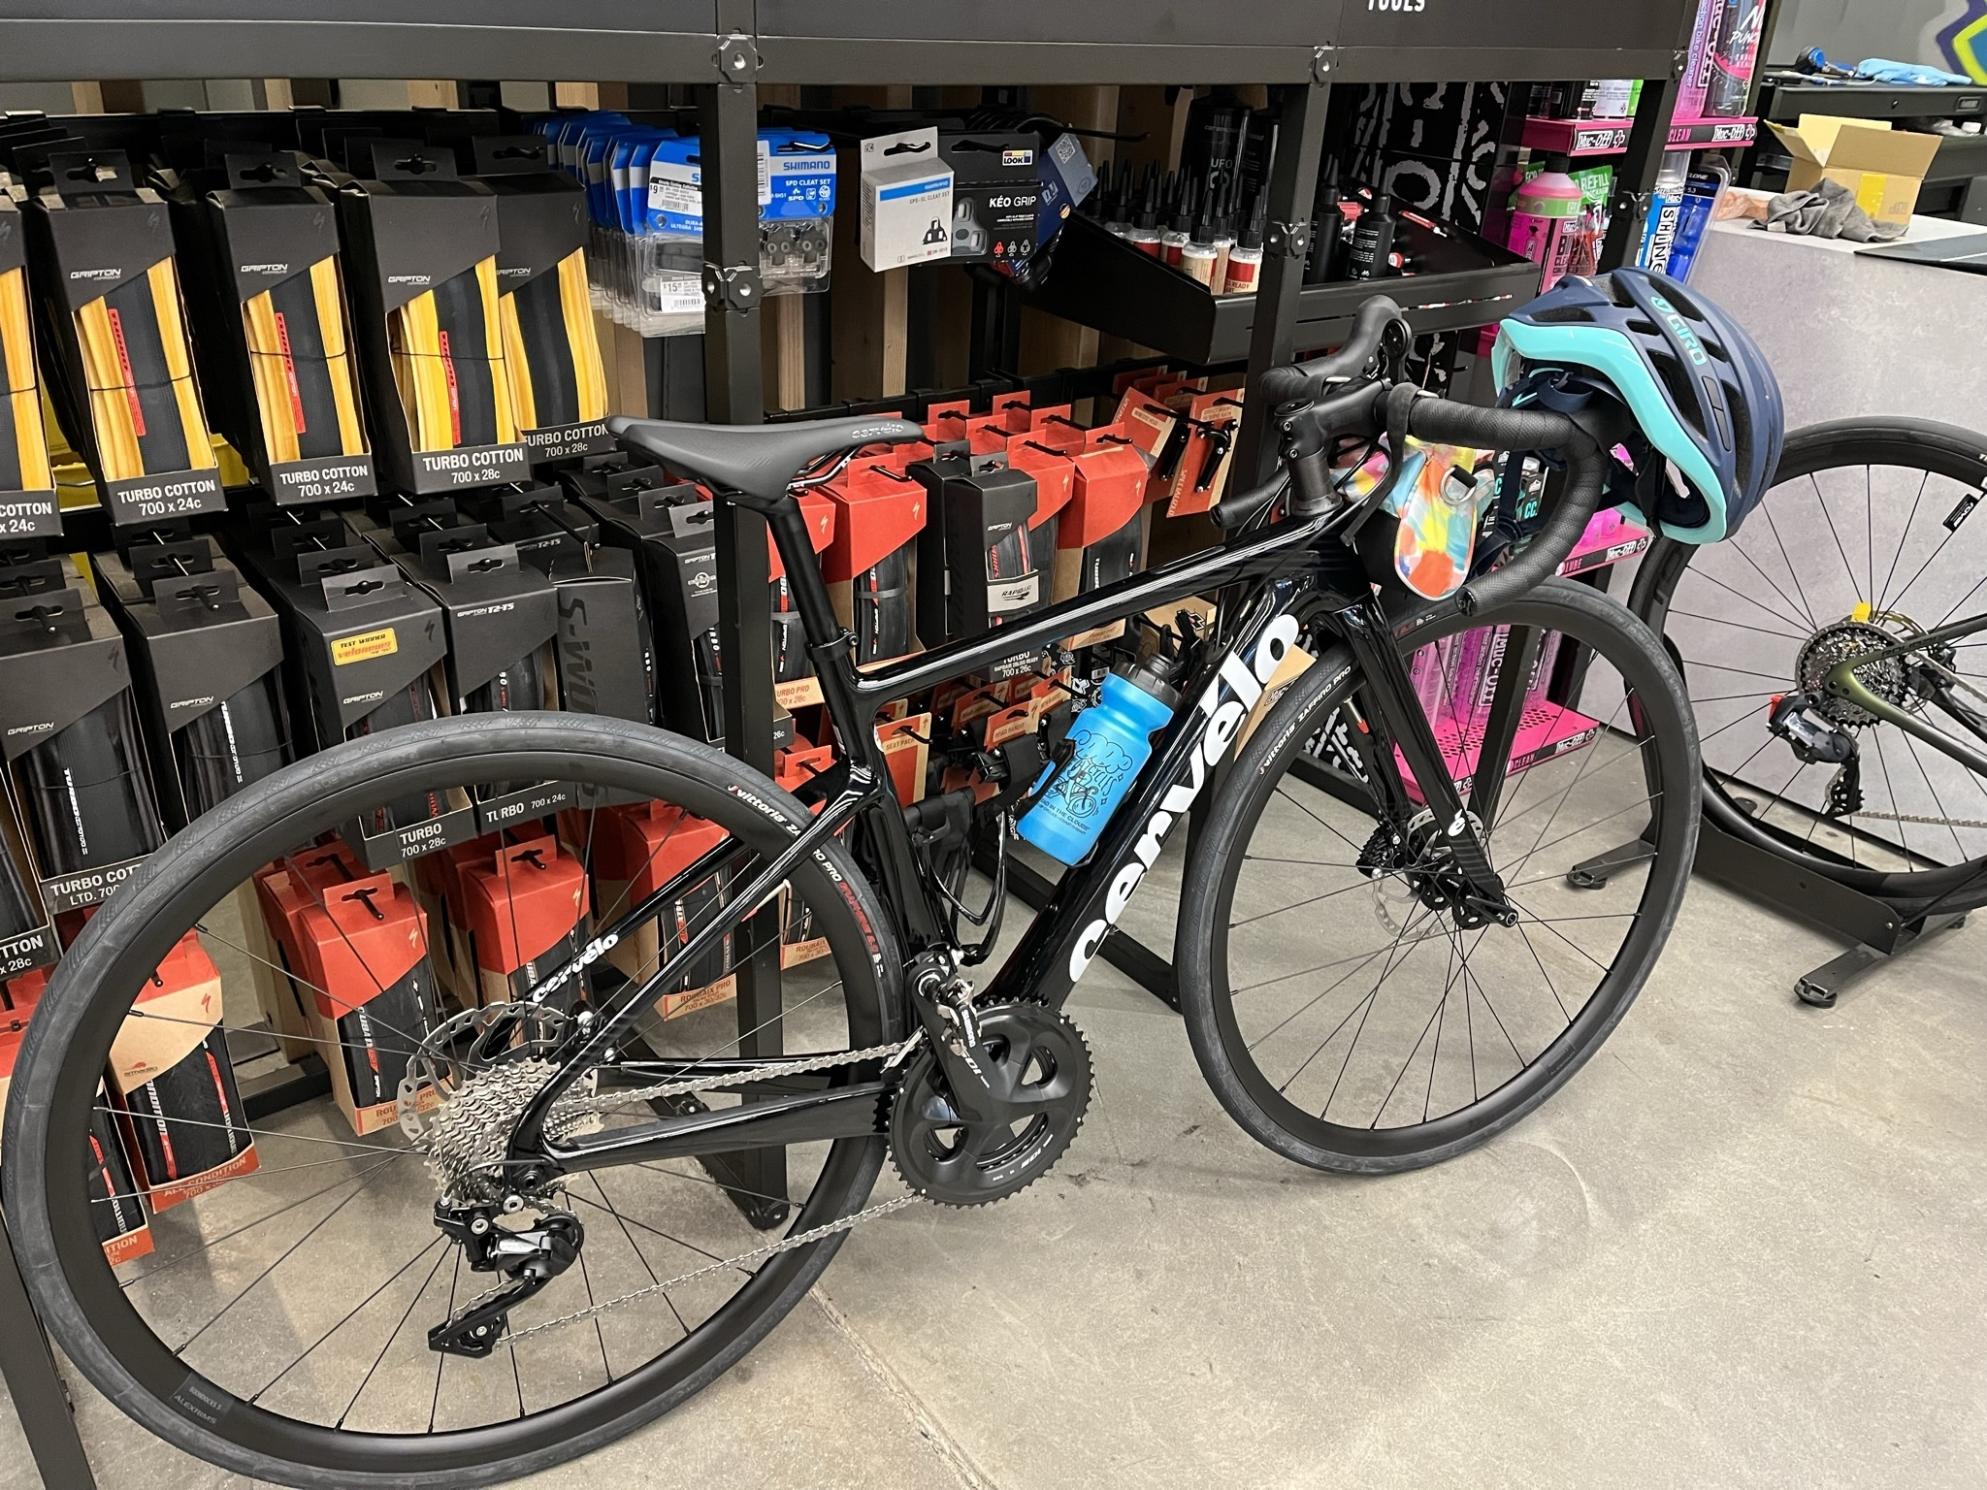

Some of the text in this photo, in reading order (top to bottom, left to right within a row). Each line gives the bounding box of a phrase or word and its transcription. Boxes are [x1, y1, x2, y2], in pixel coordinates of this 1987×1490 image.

[783, 160, 831, 171] SHIMANO
[989, 195, 1037, 208] KÉO GRIP
[70, 268, 122, 280] GRIPTON
[240, 263, 288, 273] GRIPTON
[1666, 313, 1708, 367] GIRO
[545, 446, 564, 458] 700
[571, 442, 588, 455] 28c
[422, 448, 524, 472] TURBO COTTON
[279, 465, 369, 486] TURBO COTTON
[451, 469, 501, 485] 700 x 28c
[118, 479, 216, 505] TURBO COTTON
[298, 481, 355, 497] 700 x 24c
[0, 502, 52, 518] COTTON
[138, 497, 202, 517] 700 x 24c
[10, 518, 36, 532] 24c
[170, 696, 214, 709] GRIPTON
[343, 690, 384, 705] GRIPTON
[1264, 721, 1296, 767] vittoria
[1333, 665, 1351, 685] PRO
[7, 722, 55, 736] GRIPTON
[530, 798, 546, 810] 700
[551, 792, 567, 803] 24c
[737, 787, 787, 823] vittoria
[1069, 613, 1300, 983] cervélo
[399, 822, 443, 845] TURBO
[400, 836, 447, 859] 700 x 28c
[822, 858, 842, 882] PRO
[50, 875, 103, 897] TURBO
[69, 890, 97, 906] LTD.
[9, 956, 33, 973] 28c
[532, 930, 619, 1002] cervélo
